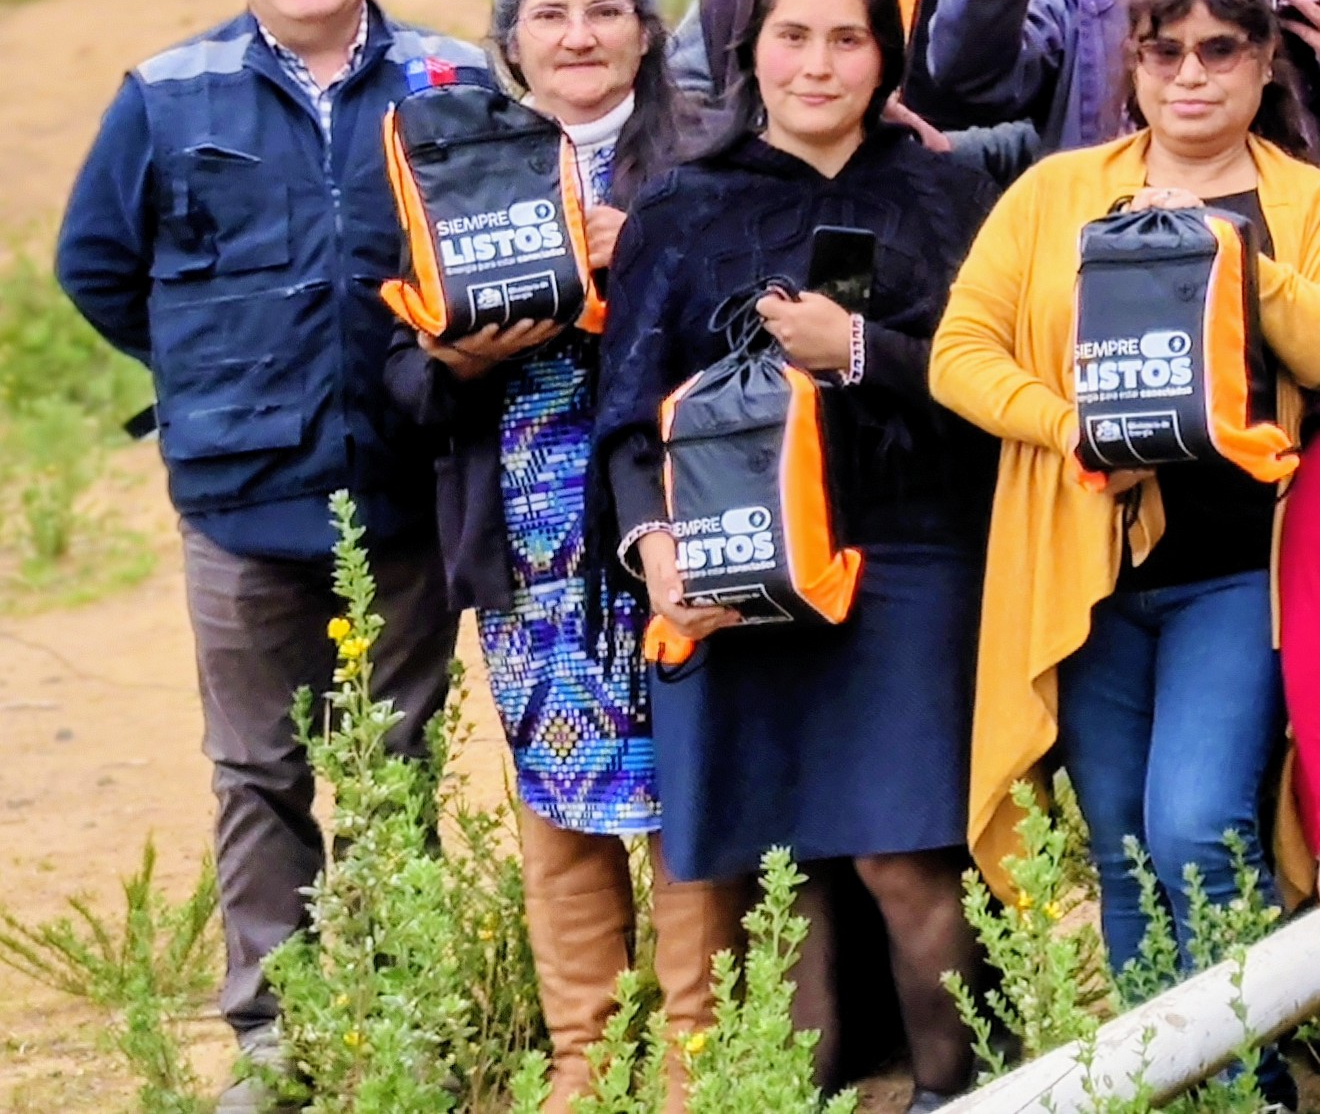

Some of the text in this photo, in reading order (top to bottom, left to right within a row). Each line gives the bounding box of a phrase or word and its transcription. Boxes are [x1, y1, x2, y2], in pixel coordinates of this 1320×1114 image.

[436, 210, 509, 236] SIEMPRE
[440, 221, 563, 267] LISTOS
[1074, 357, 1193, 392] LISTOS
